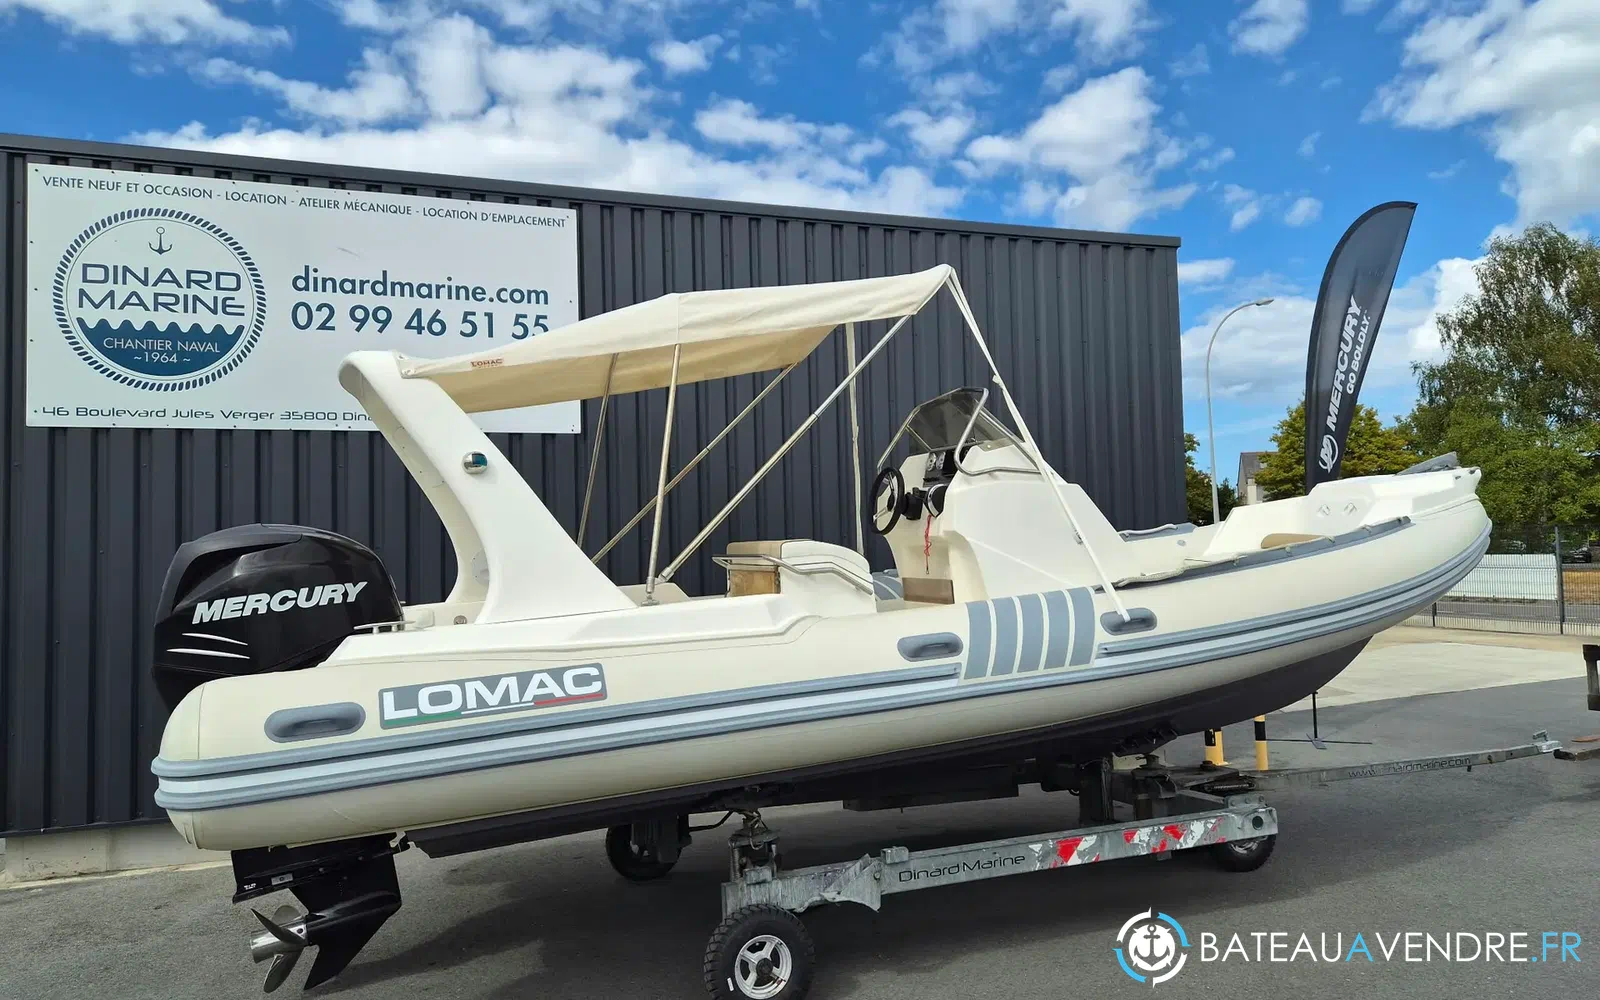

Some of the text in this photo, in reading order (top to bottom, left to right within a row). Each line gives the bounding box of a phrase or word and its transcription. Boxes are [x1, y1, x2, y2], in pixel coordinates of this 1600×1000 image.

[42, 175, 84, 189] VENTE
[88, 179, 122, 192] NEUF
[126, 182, 140, 193] ET
[143, 183, 213, 200] OCCASION
[225, 190, 287, 205] LOCATION
[298, 197, 340, 210] ATELIER
[343, 198, 412, 216] MÉCANIQUE
[422, 207, 478, 221] LOCATION
[480, 212, 566, 228] D'EMPLACEMENT
[81, 263, 242, 292] DINARD
[291, 264, 549, 306] dinardmarine.com
[78, 288, 246, 317] MARINE
[291, 301, 336, 332] 02
[348, 304, 393, 334] 99
[404, 307, 447, 337] 46
[459, 310, 495, 338] 51
[103, 337, 221, 353] CHANTIER NAVAL
[1326, 295, 1362, 432] MERCURY
[1346, 372, 1357, 395] GO
[42, 406, 70, 417] 46
[75, 406, 167, 418] Boulevard
[171, 408, 215, 419] Jules
[220, 409, 275, 422] Verger
[279, 411, 338, 421] 35800
[192, 581, 368, 625] MERCURY
[383, 666, 603, 720] LOMAC
[898, 855, 1026, 882] Dinard Marine
